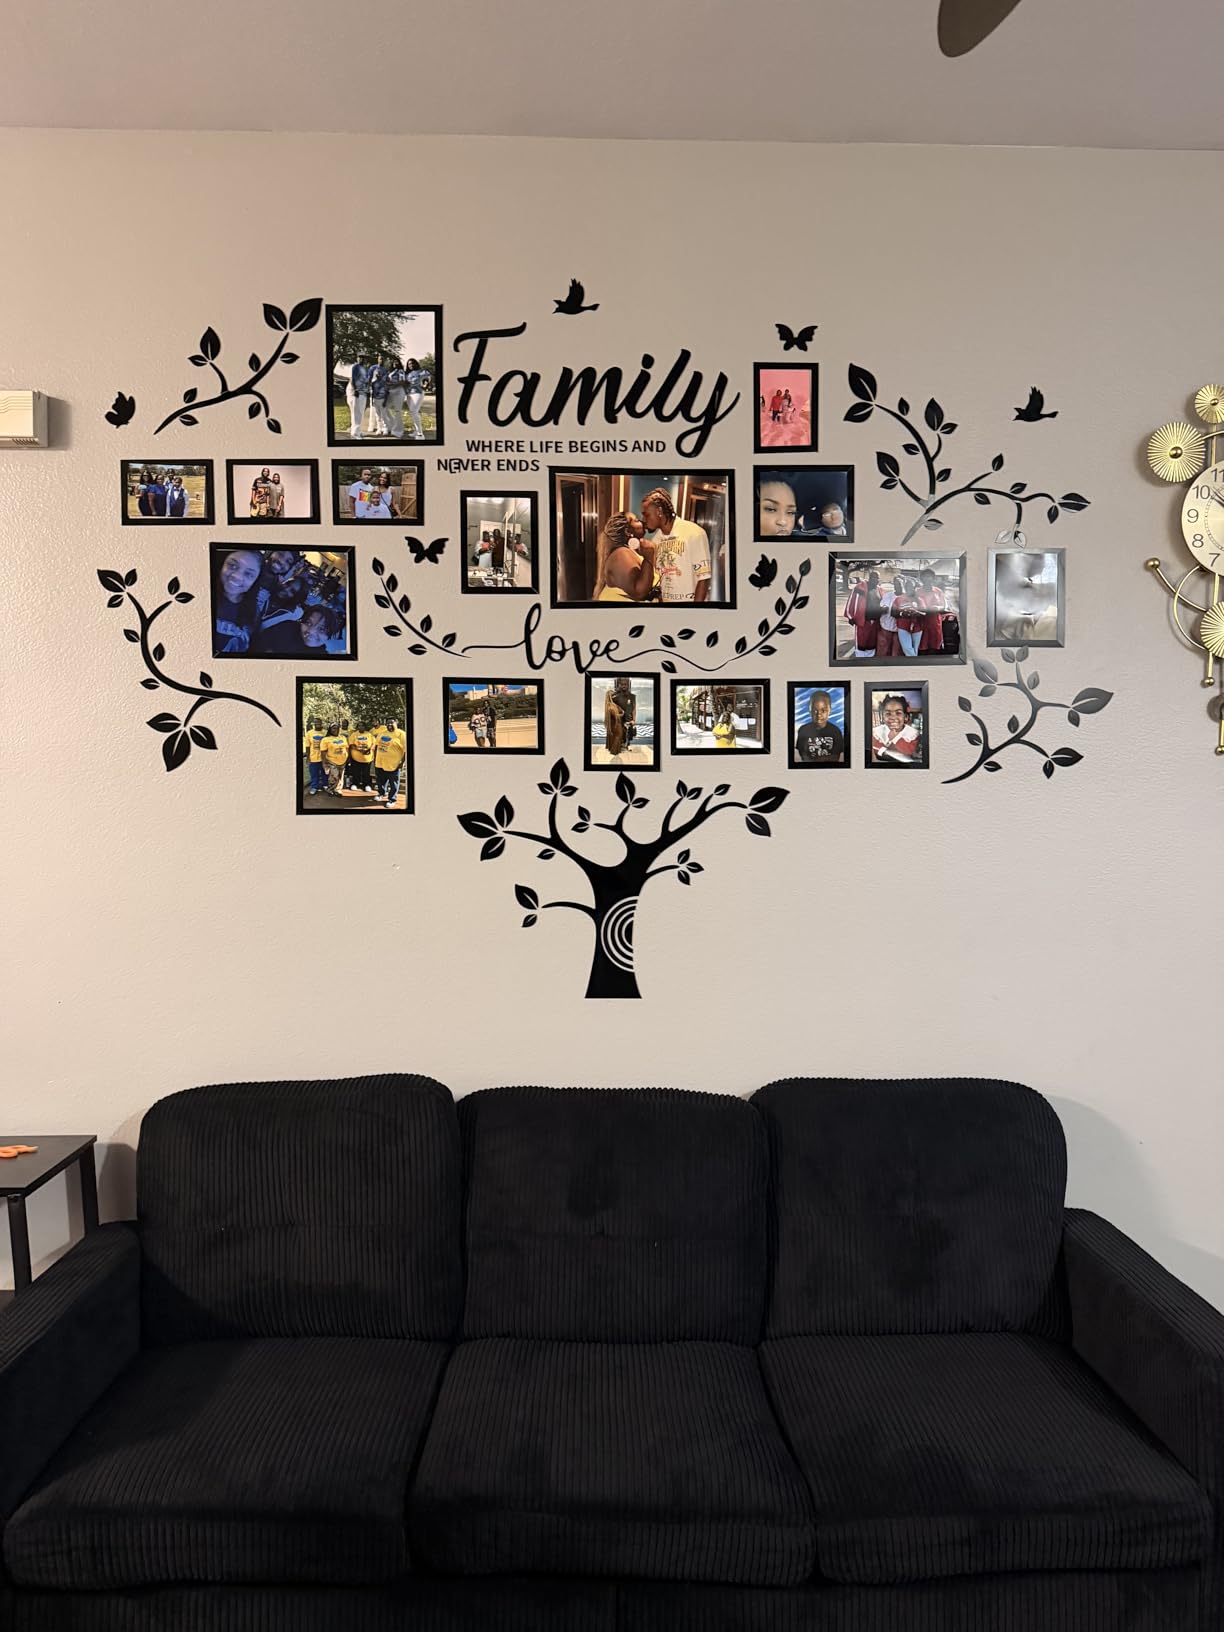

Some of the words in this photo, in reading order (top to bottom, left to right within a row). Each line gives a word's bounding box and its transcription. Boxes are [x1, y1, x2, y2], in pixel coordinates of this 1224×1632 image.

[453, 321, 741, 459] Family
[465, 439, 526, 453] WHERE
[529, 440, 564, 454] LIFE
[568, 439, 629, 453] BEGINS
[631, 439, 667, 453] AND
[437, 457, 491, 474] NEVER
[496, 458, 540, 472] ENDS
[1192, 484, 1211, 500] 10
[1186, 508, 1199, 524] 9
[1191, 533, 1204, 549] 8
[1208, 552, 1221, 567] 7
[524, 602, 620, 674] love
